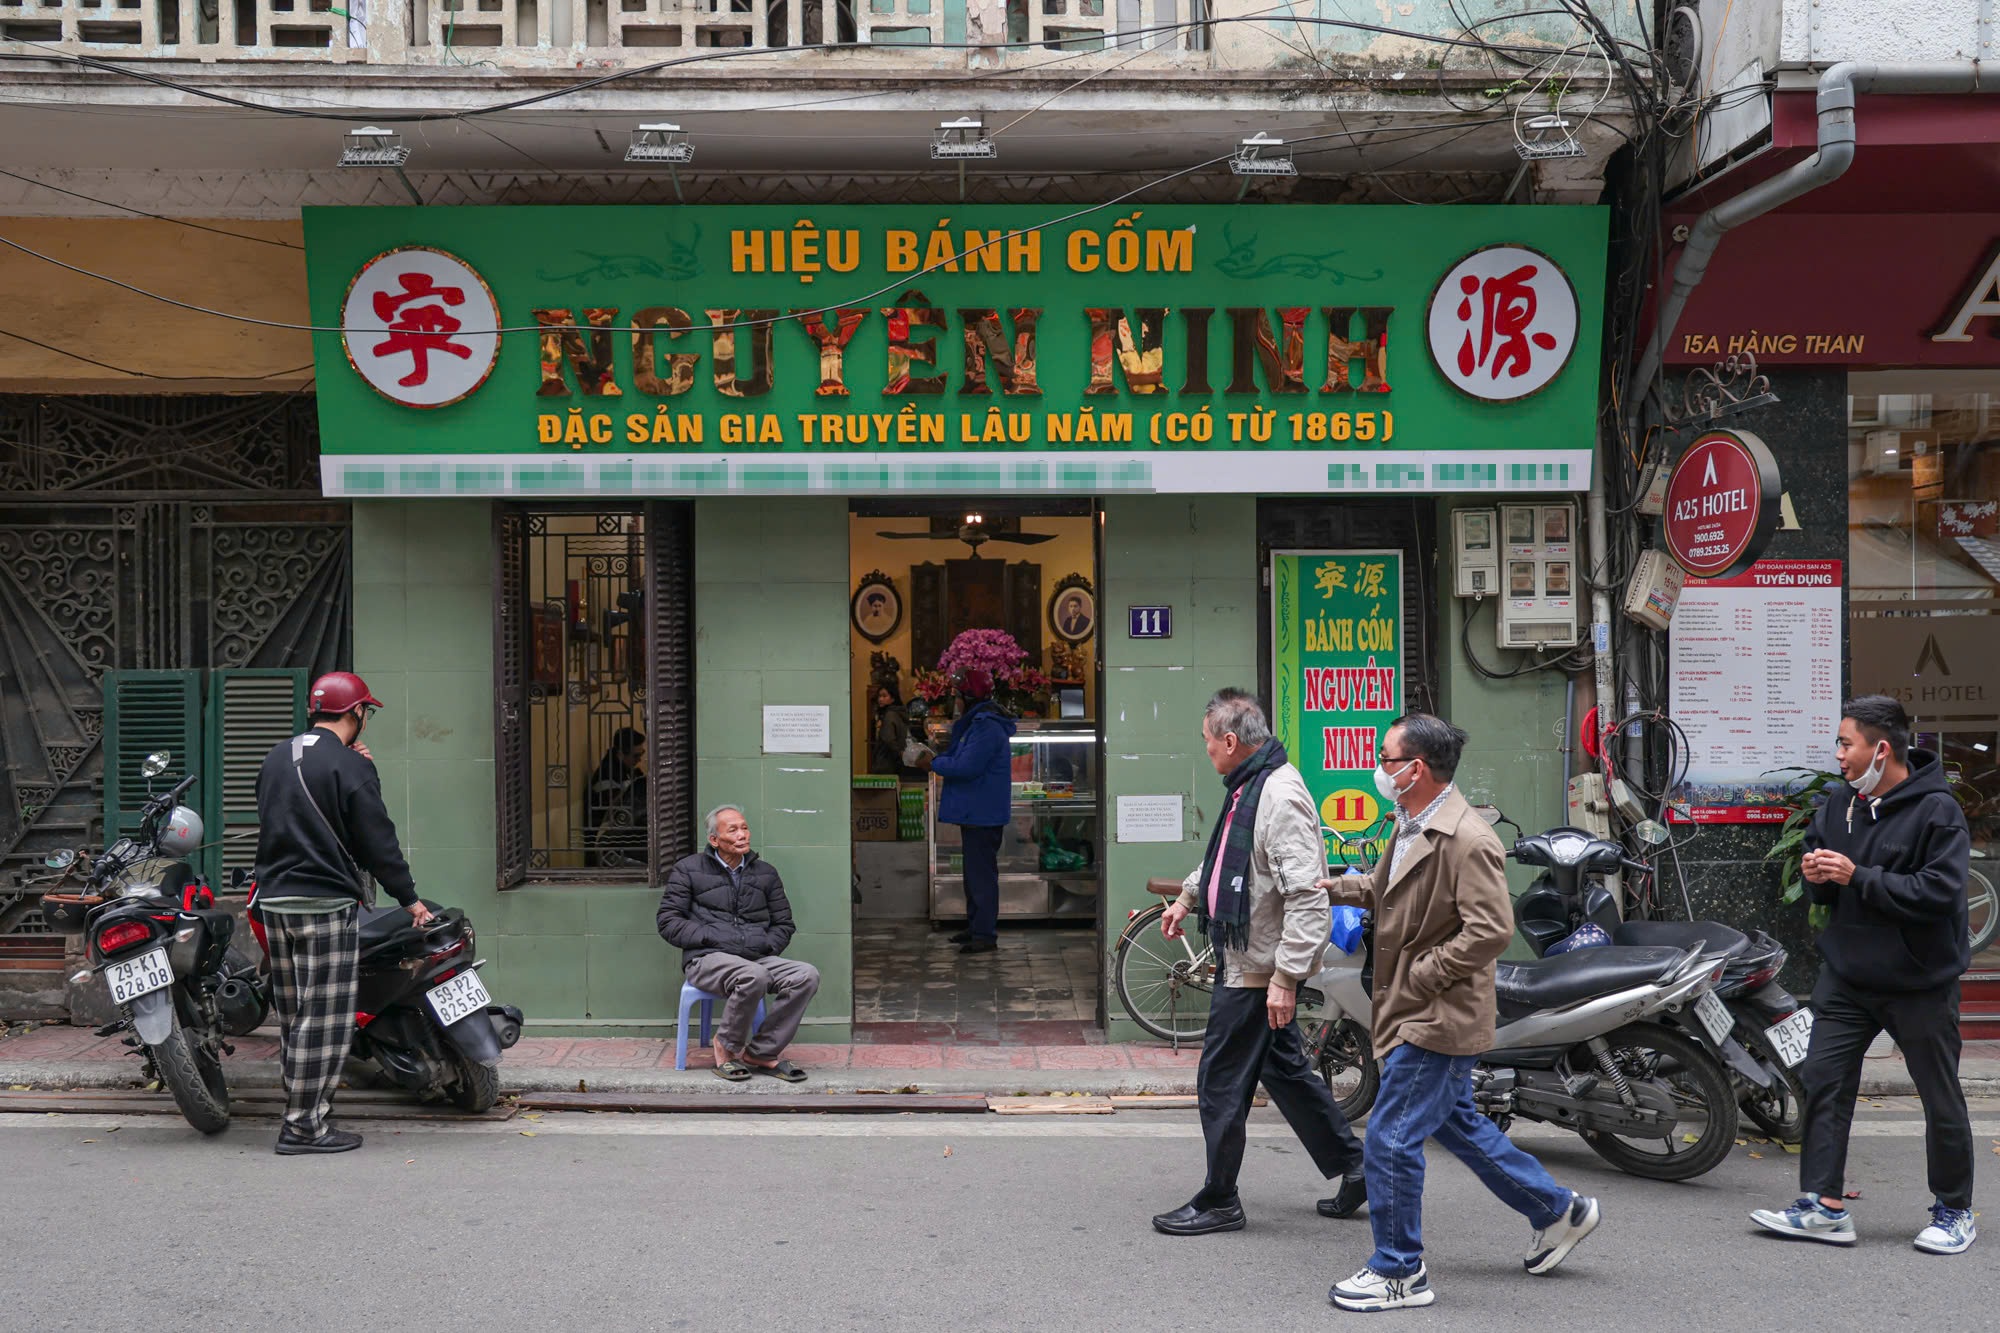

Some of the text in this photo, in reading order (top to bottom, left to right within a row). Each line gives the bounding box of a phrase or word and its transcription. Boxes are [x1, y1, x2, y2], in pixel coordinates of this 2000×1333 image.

[731, 212, 1194, 283] HIỆU BÁNH CỐM
[1457, 264, 1557, 381] 源
[531, 289, 1396, 397] NGUYÊN NINH
[1683, 329, 1865, 354] 15A HÀNG THAN
[537, 402, 1393, 450] ĐẶC SẢN GIA TRUYỀN LÂU NĂM (CÓ TỪ 1865)
[1674, 488, 1748, 521] A25 HOTEL
[1694, 530, 1725, 543] 1900.6925
[1139, 609, 1162, 634] 11
[1304, 602, 1394, 651] BÁNH CỐM
[1304, 656, 1394, 712] NGUYÊN
[1922, 686, 1985, 702] HOTEL
[1323, 727, 1376, 770] NINH
[1331, 796, 1369, 821] 11
[114, 953, 158, 982] 29-K1
[115, 968, 169, 1000] 828.08
[434, 975, 474, 1004] 59-P2
[440, 988, 487, 1022] 825.50
[1774, 1014, 1812, 1045] 29-E2
